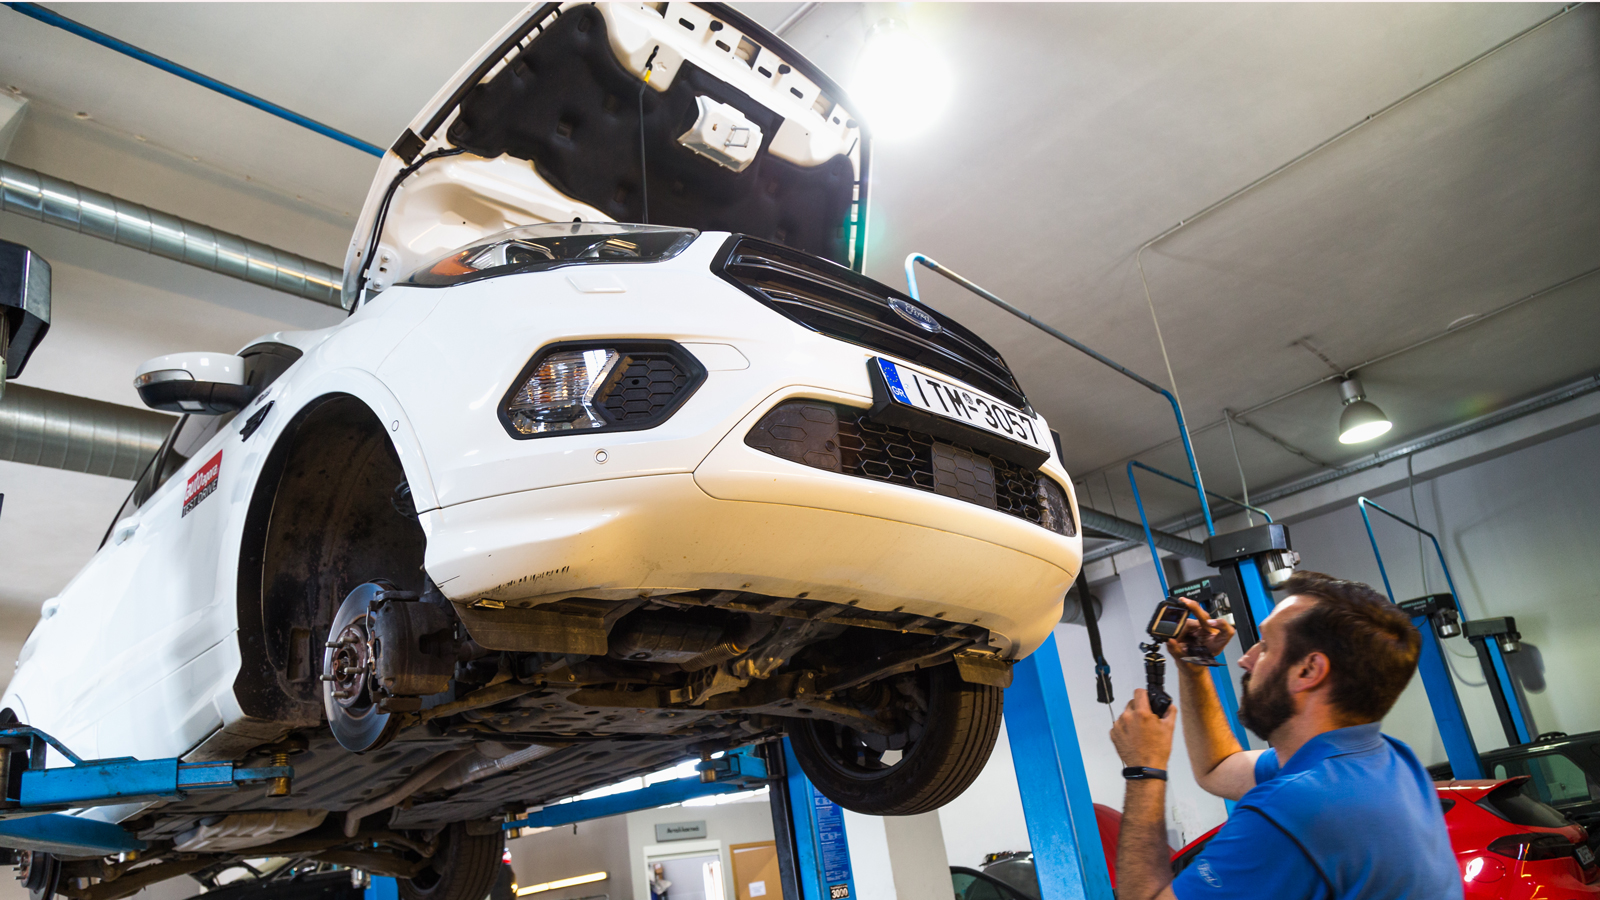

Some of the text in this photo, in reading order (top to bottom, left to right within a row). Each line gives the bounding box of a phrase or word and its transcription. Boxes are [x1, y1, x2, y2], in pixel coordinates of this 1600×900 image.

[904, 302, 933, 324] Ford
[891, 385, 907, 399] GR
[182, 478, 218, 517] TEST DRIVE
[831, 888, 848, 899] 3000
